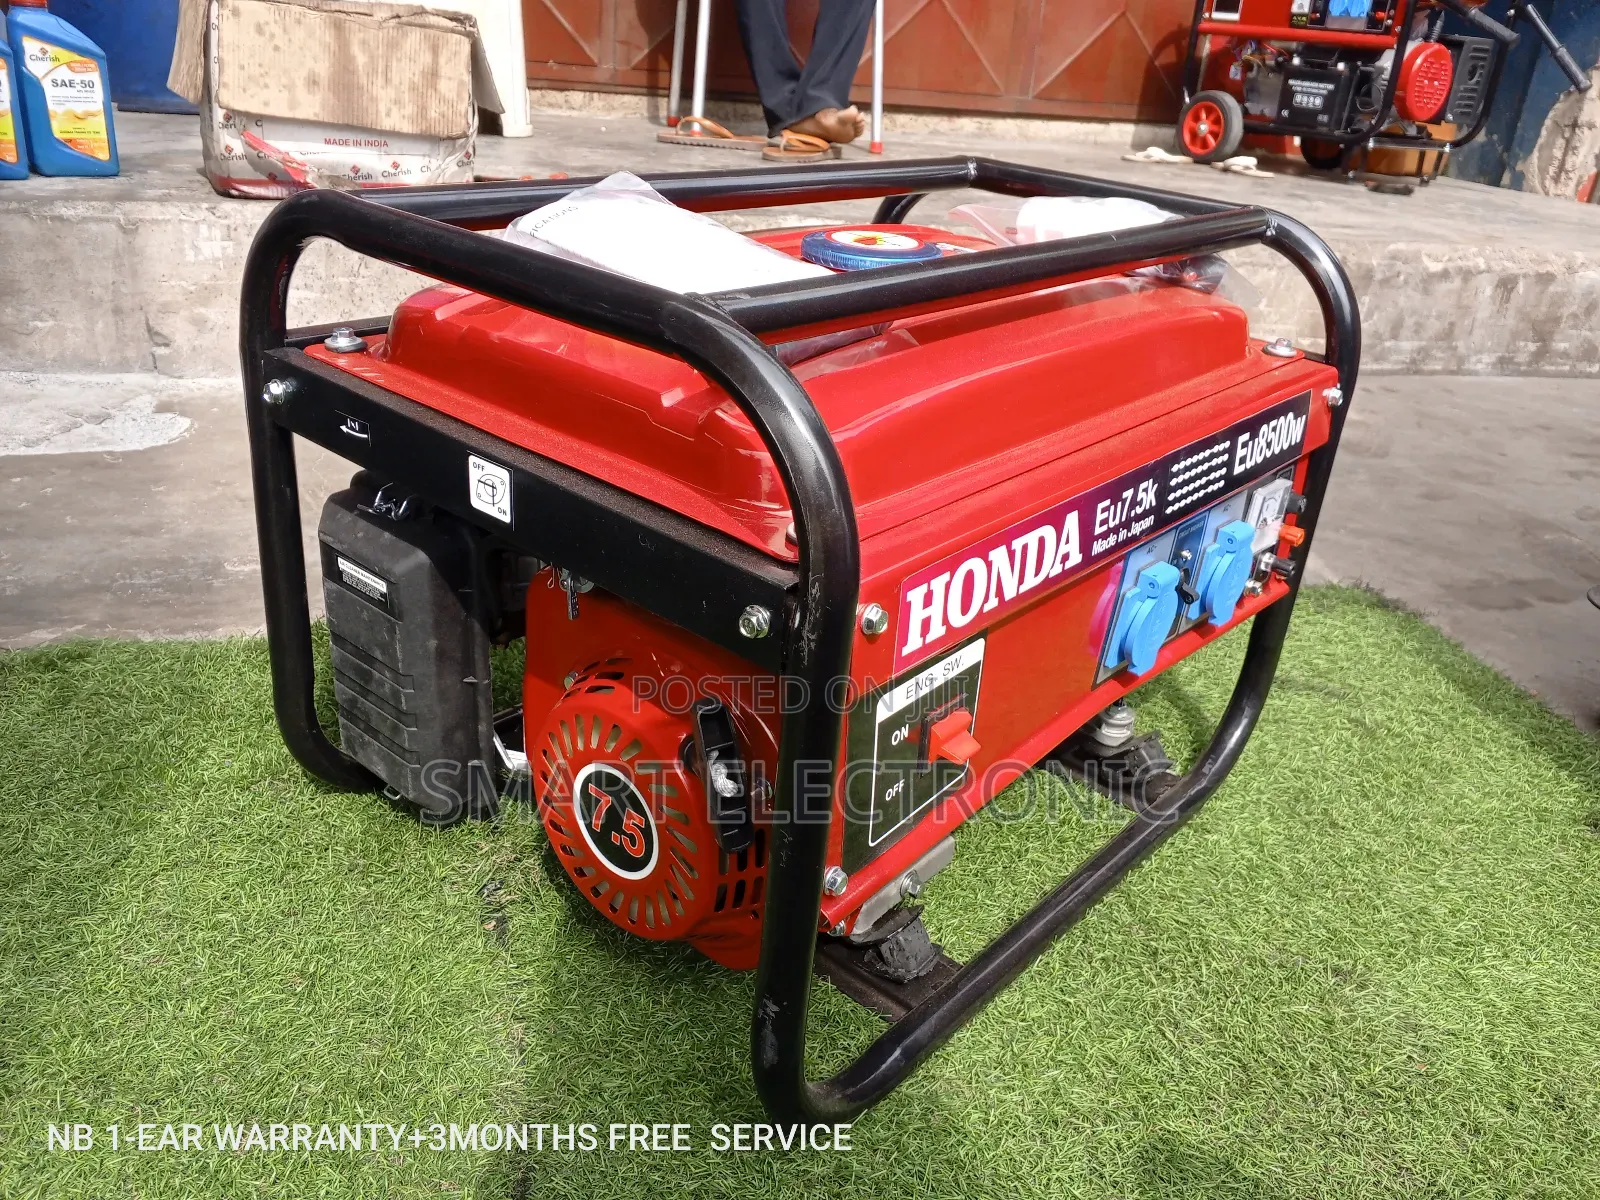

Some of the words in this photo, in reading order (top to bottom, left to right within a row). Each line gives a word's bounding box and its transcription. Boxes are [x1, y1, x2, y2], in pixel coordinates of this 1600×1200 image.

[29, 53, 60, 63] Cherish
[51, 78, 95, 89] SAE-50
[324, 138, 350, 146] MADE
[352, 139, 362, 147] IN
[364, 140, 389, 148] INDIA
[342, 172, 373, 181] herish
[381, 168, 412, 178] Cherish
[1233, 412, 1307, 477] Eu8500w
[472, 461, 485, 473] OFF
[497, 506, 507, 517] ON
[1094, 479, 1158, 536] Eu7.5k
[1091, 533, 1117, 556] Made
[1117, 527, 1127, 543] in
[1127, 514, 1155, 541] Japan
[901, 510, 1083, 658] HONDA
[943, 655, 965, 677] SW.
[891, 723, 910, 746] ON
[885, 779, 905, 801] OFF
[588, 783, 646, 858] 7.5
